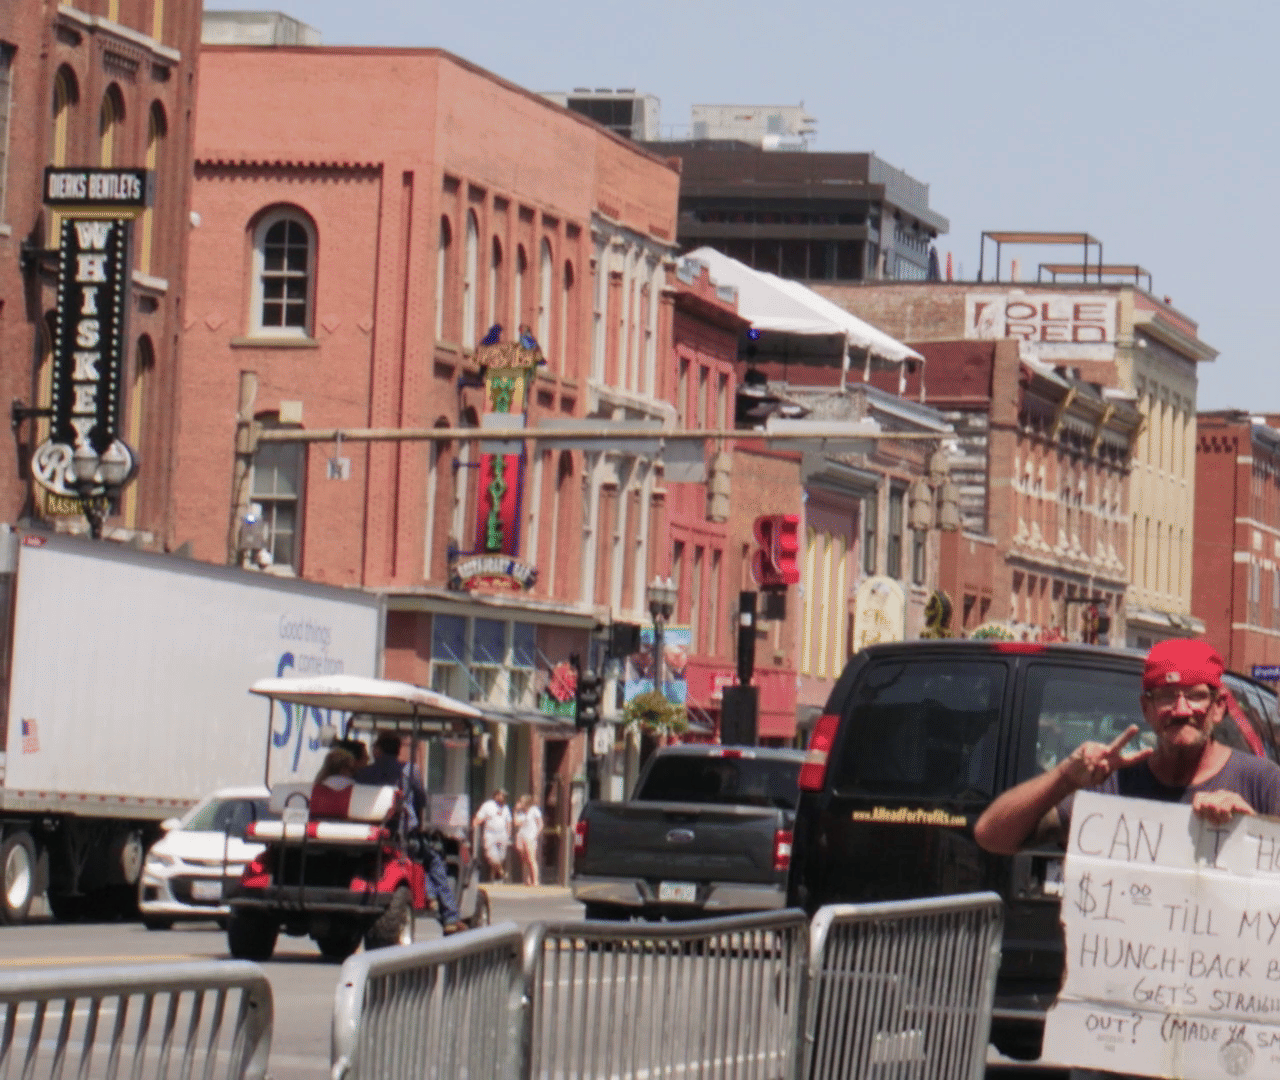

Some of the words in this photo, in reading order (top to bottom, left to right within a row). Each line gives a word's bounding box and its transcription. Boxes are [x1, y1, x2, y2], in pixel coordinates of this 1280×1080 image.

[1004, 302, 1108, 322] OLE
[68, 220, 114, 456] WHISKEY
[1004, 322, 1107, 344] RED
[279, 613, 303, 640] Good
[304, 616, 332, 646] things
[1076, 812, 1164, 864] CAN
[1085, 1011, 1144, 1044] OUT?
